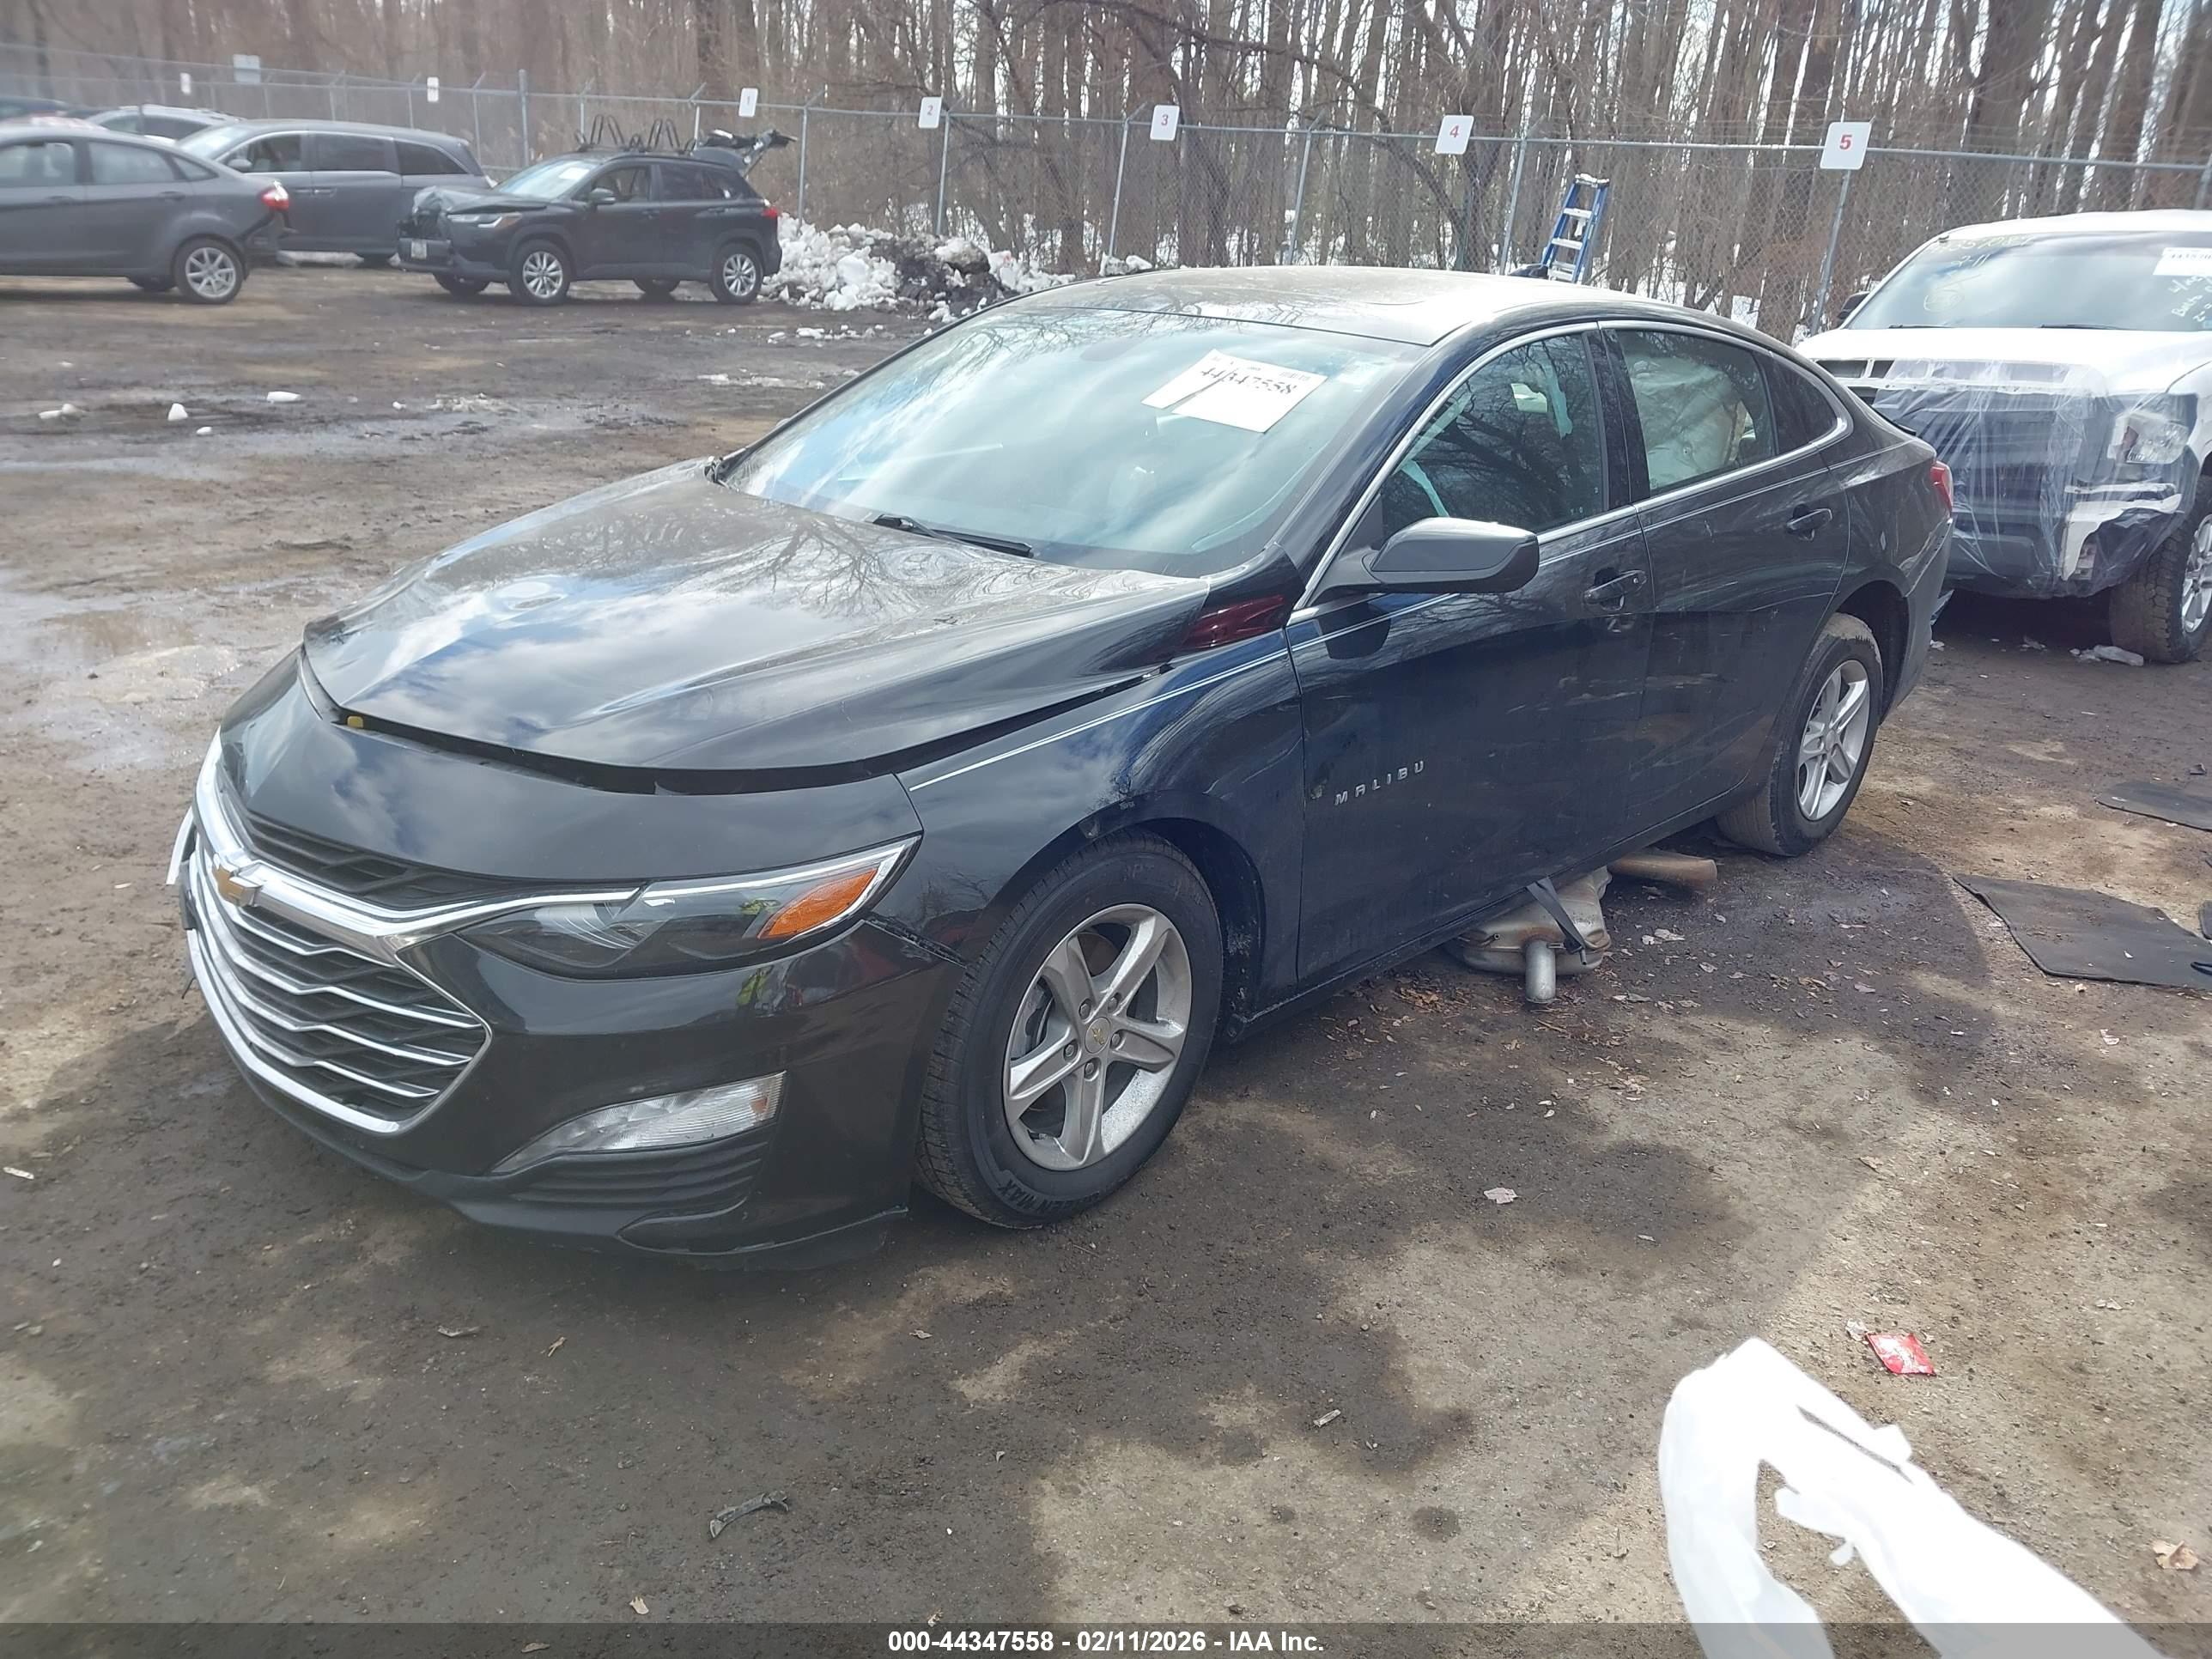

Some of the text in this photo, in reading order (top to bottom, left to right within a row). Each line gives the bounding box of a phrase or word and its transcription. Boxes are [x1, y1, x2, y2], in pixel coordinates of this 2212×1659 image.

[927, 104, 934, 116] 2
[1161, 113, 1169, 126] 3
[1449, 125, 1460, 138] 4
[1839, 134, 1853, 150] 5
[1334, 760, 1425, 806] MALIBU
